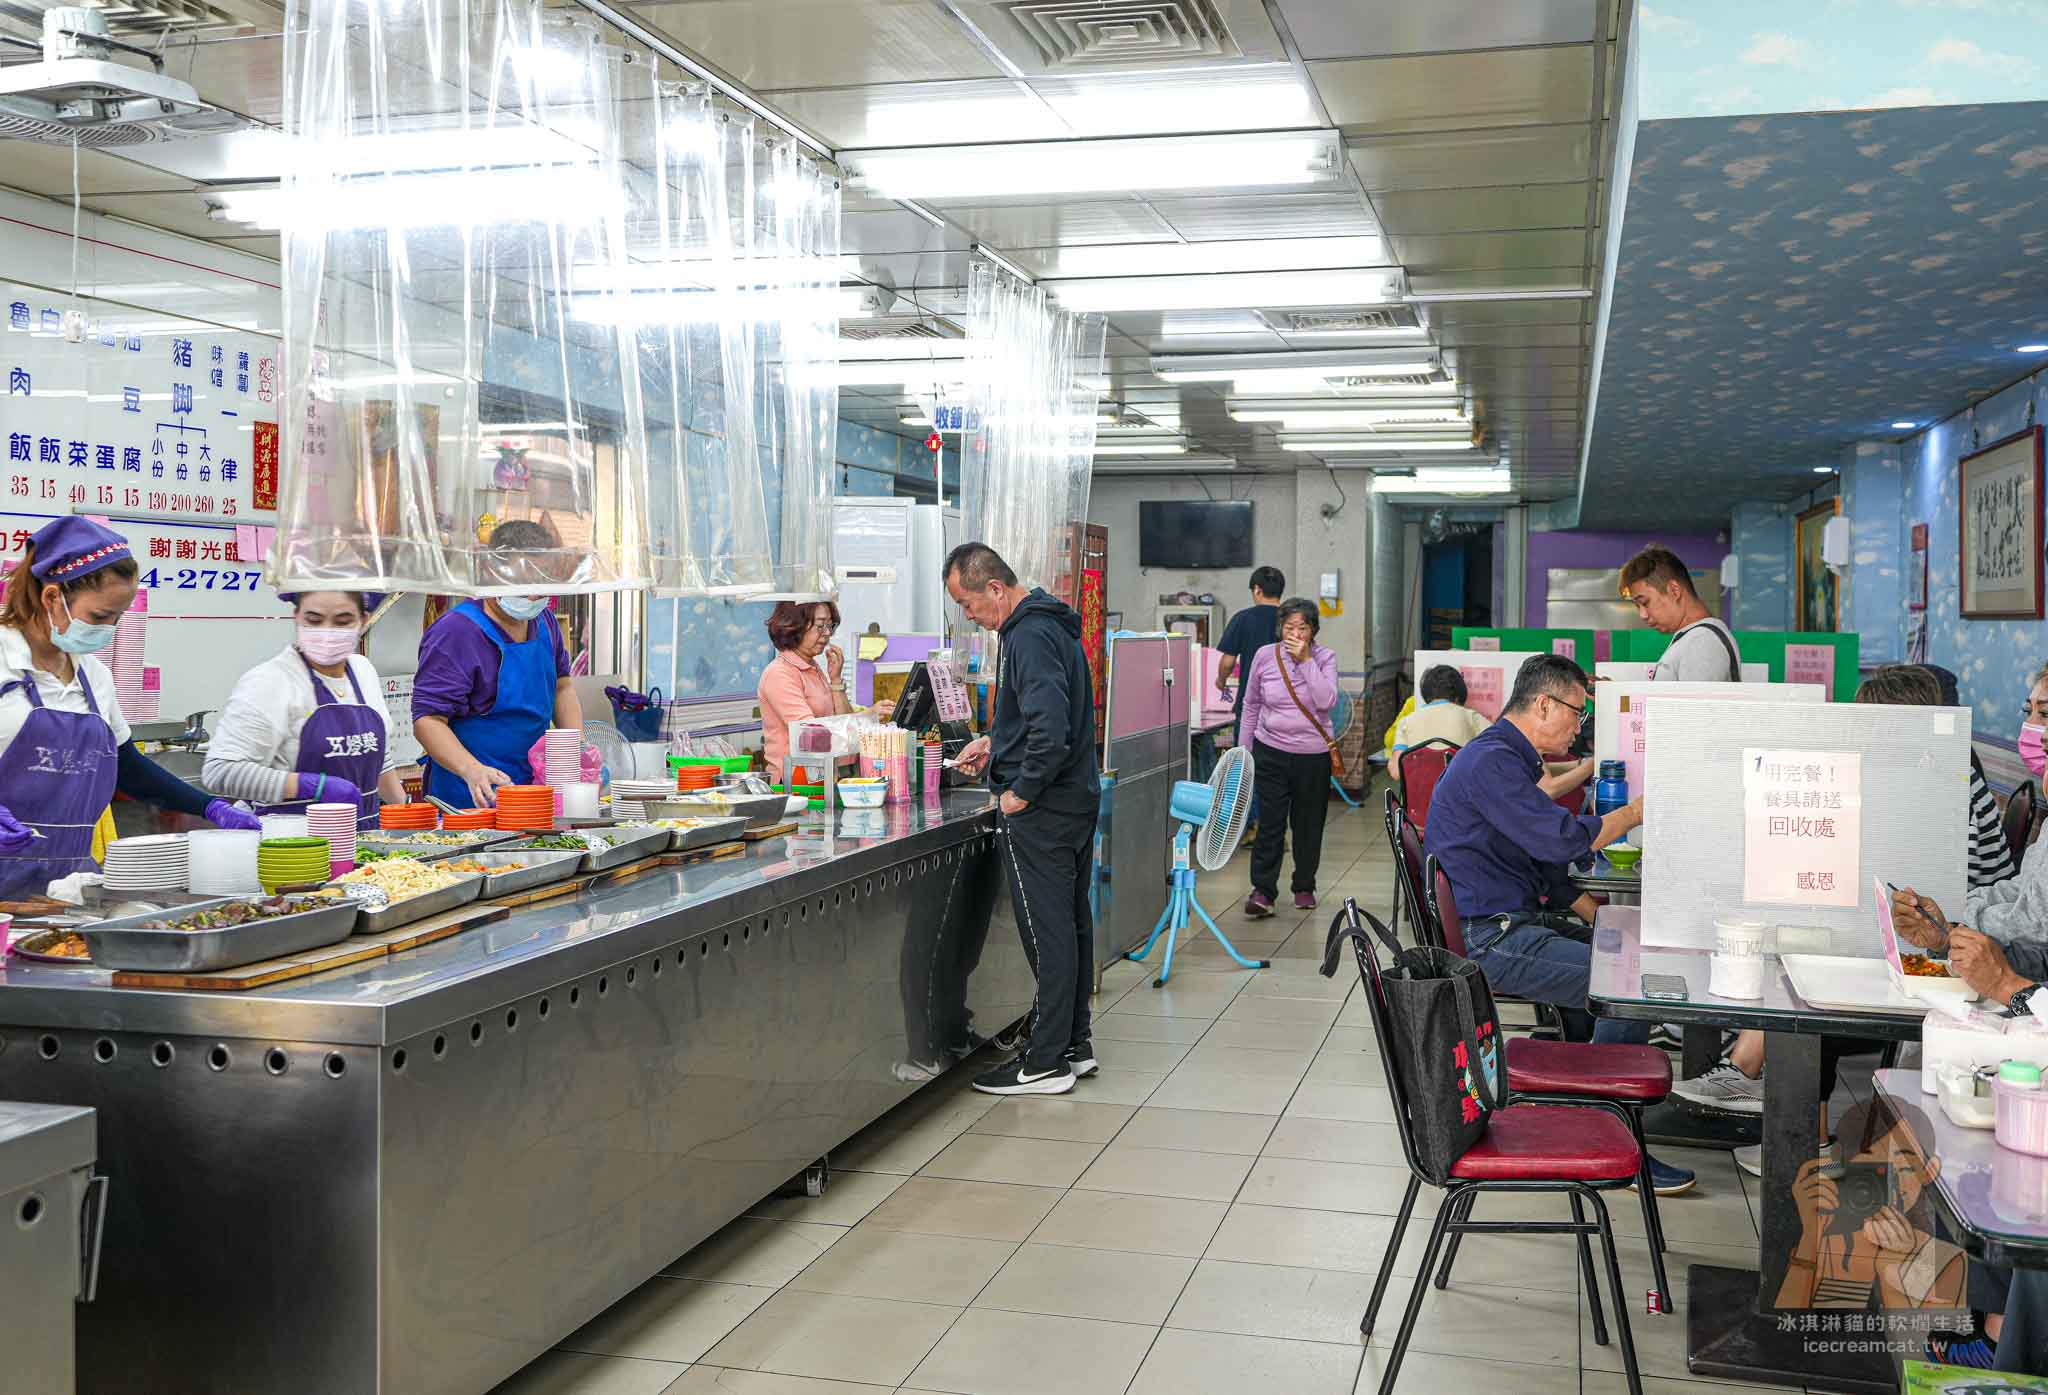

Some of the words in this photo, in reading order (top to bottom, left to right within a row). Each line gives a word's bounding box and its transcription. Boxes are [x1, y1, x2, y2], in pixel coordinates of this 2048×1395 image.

[152, 438, 164, 478] 小份
[176, 441, 188, 480] 中份
[200, 444, 211, 482] 大份
[11, 475, 29, 496] 35
[40, 479, 56, 498] 15
[68, 484, 85, 503] 40
[97, 485, 113, 504] 15
[124, 488, 139, 506] 15
[149, 492, 167, 510] 130
[171, 494, 192, 512] 200
[195, 495, 213, 513] 260
[222, 498, 236, 516] 25
[1769, 815, 1836, 838] 回收處
[1797, 871, 1836, 891] 感恩
